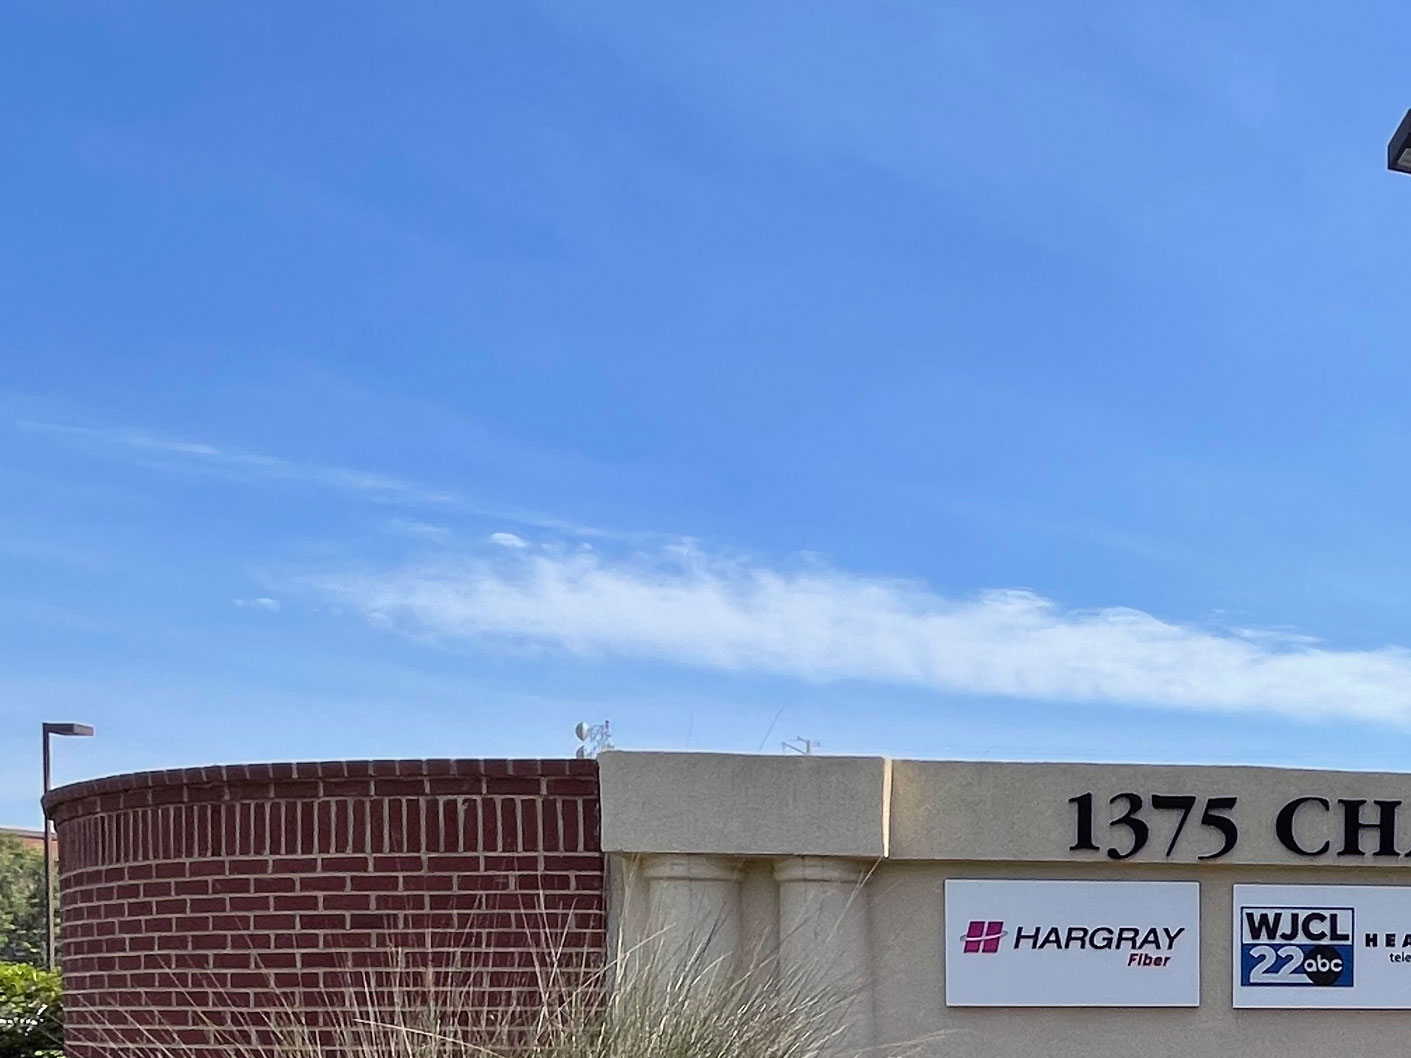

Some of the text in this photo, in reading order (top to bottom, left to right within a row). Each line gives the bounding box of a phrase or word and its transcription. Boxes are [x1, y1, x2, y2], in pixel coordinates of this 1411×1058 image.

[1068, 792, 1238, 860] 1375
[1013, 926, 1185, 950] HARGRAY
[1245, 912, 1350, 941] WJCL
[1127, 953, 1171, 967] Fiber
[1249, 945, 1343, 983] 22 abc
